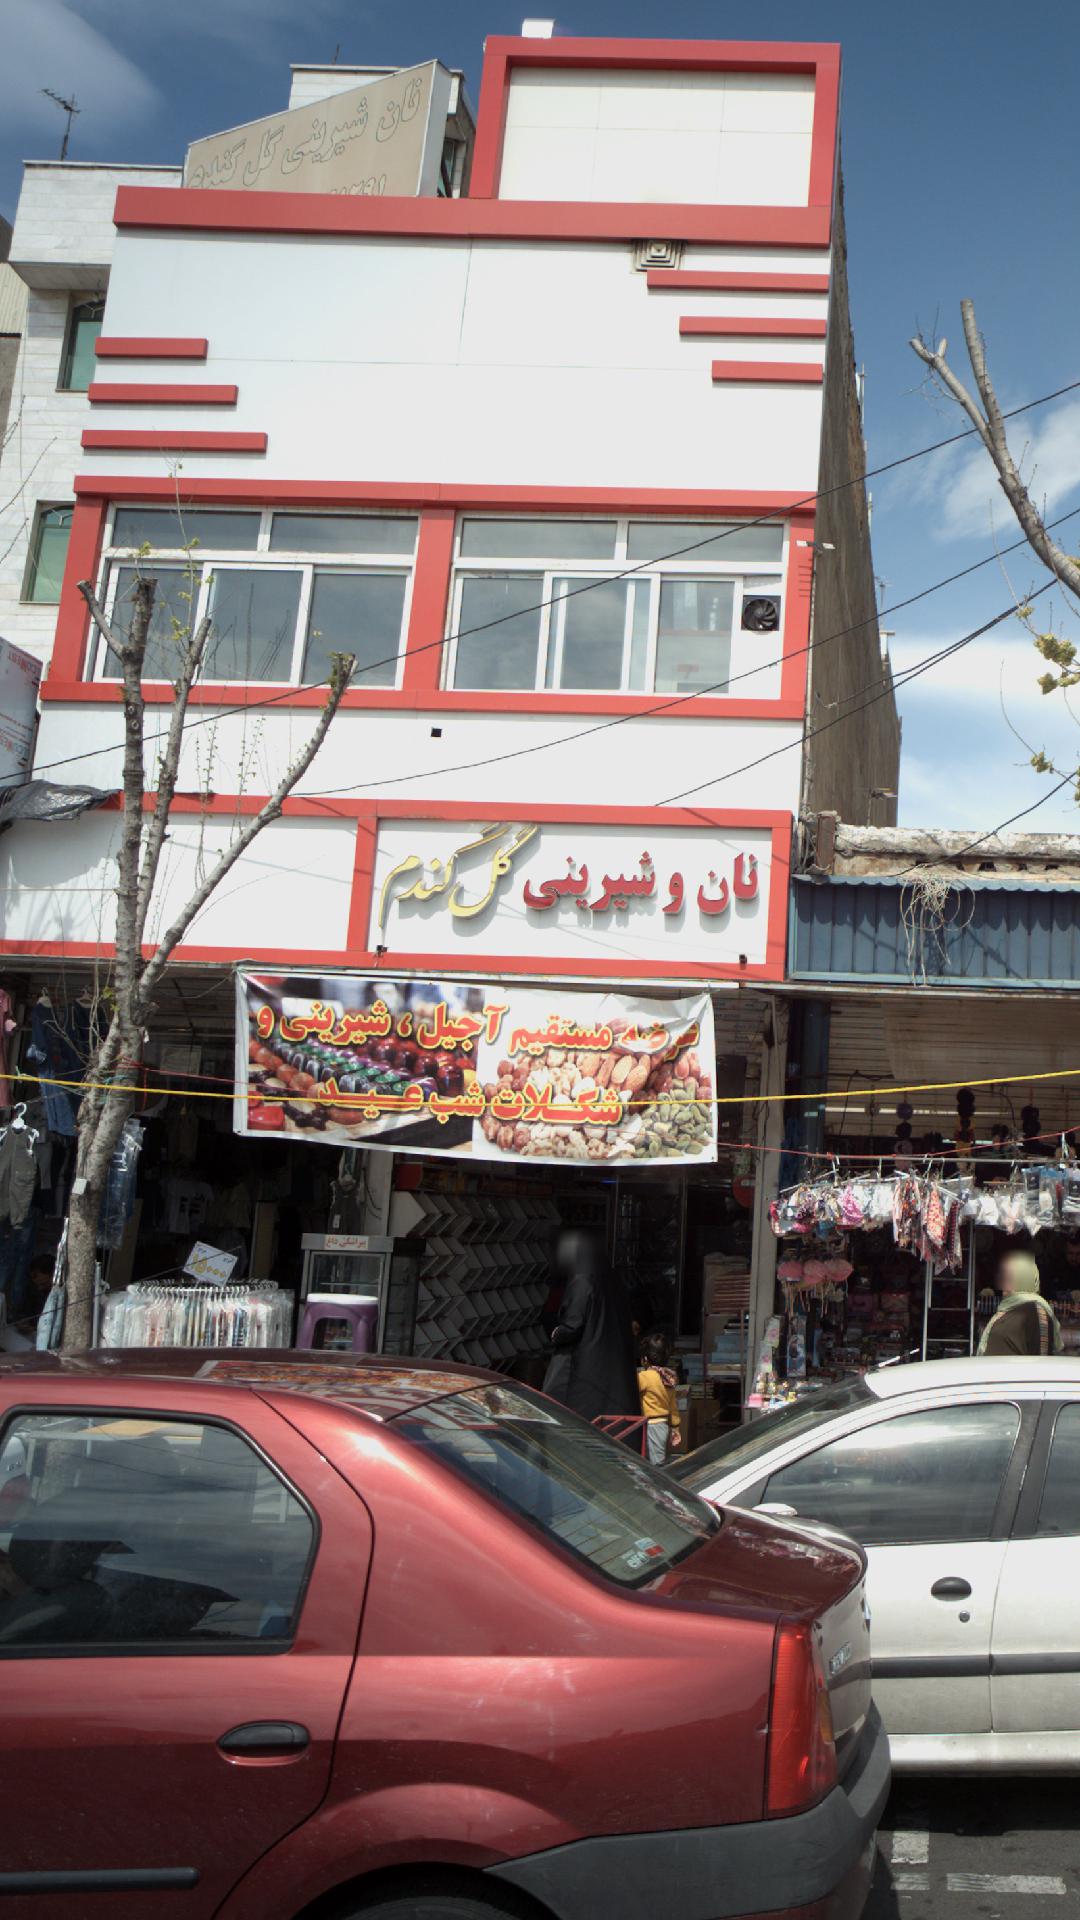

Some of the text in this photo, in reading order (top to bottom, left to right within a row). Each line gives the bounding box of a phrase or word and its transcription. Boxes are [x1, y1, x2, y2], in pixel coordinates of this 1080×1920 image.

[376, 77, 422, 143] نان
[242, 124, 287, 187] گل
[378, 822, 758, 928] نان و شیرینی گل گندم
[257, 1005, 275, 1039] و
[279, 1000, 392, 1046] شیرینی
[417, 1001, 509, 1049] آجیل
[508, 1014, 613, 1056] مستقیم
[317, 1077, 624, 1124] شکلات شب عید
